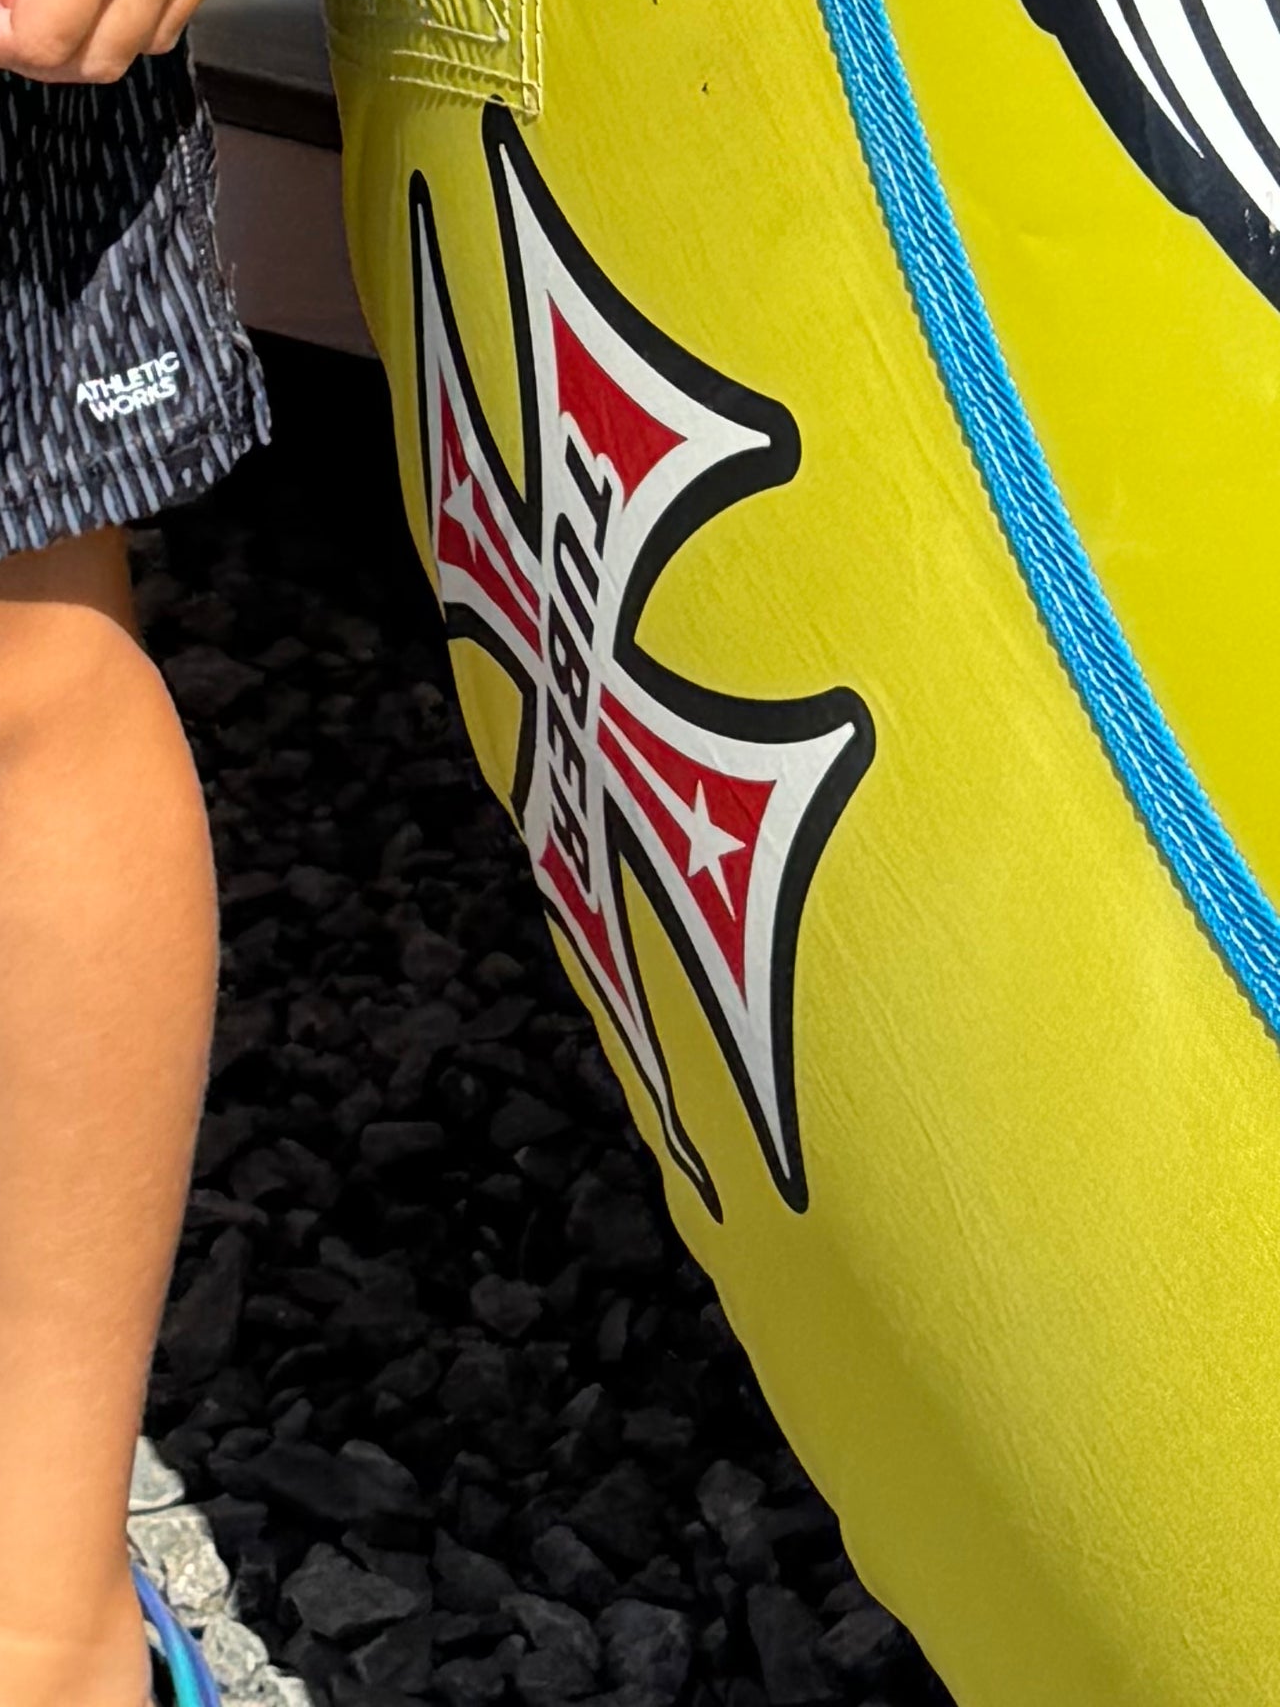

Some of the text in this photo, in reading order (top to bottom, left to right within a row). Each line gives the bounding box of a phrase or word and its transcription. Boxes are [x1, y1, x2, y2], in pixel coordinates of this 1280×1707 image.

[76, 351, 180, 405] ATHLETIC
[89, 376, 177, 422] WORKS
[546, 434, 612, 895] TUBER
